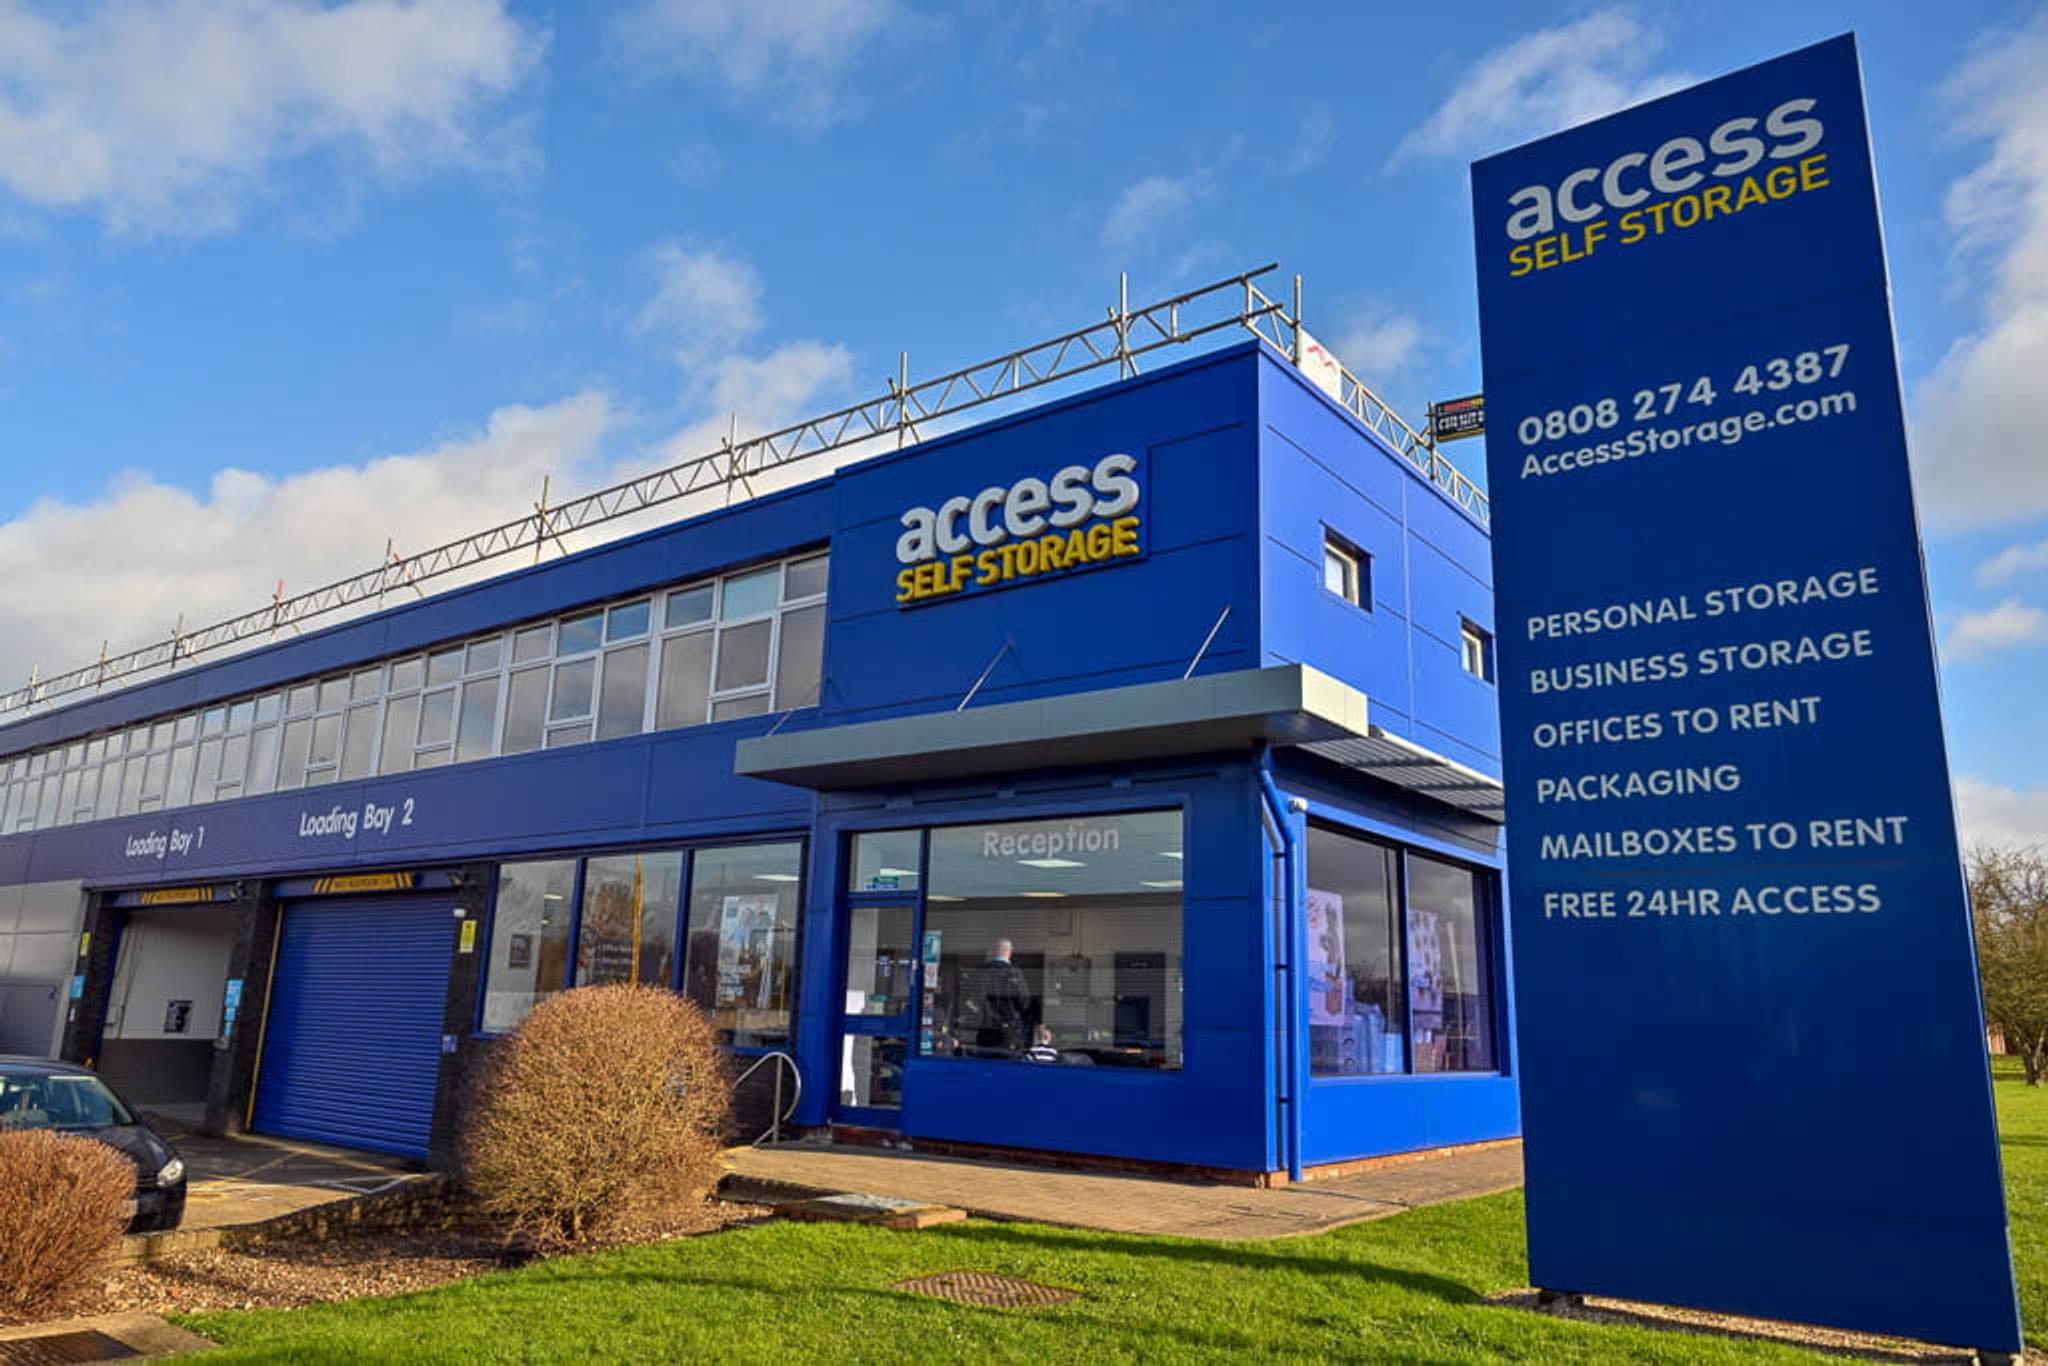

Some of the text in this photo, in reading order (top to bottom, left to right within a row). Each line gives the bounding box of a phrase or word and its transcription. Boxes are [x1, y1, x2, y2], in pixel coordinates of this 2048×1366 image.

[1507, 98, 1824, 240] access
[1509, 153, 1830, 277] SELF STORAGE
[1518, 398, 1620, 446] 0808
[1633, 376, 1717, 421] 274
[1733, 344, 1850, 395] 4387
[1520, 391, 1857, 479] AccessStorage.com
[896, 453, 1140, 564] access
[895, 516, 1140, 602] SELF STORAGE
[1527, 567, 1879, 641] PERSONAL STORAGE
[1531, 629, 1873, 694] BUSINESS STORAGE
[1533, 696, 1821, 748] OFFICES TO RENT
[1537, 764, 1741, 803] PACKAGING
[126, 827, 204, 859] Loading Bay 1
[300, 798, 415, 838] Loading Bay 2
[983, 825, 1120, 860] Reception
[1541, 816, 1908, 860] MAILBOXES TO RENT
[1544, 883, 1881, 918] FREE 24HR ACCESS
